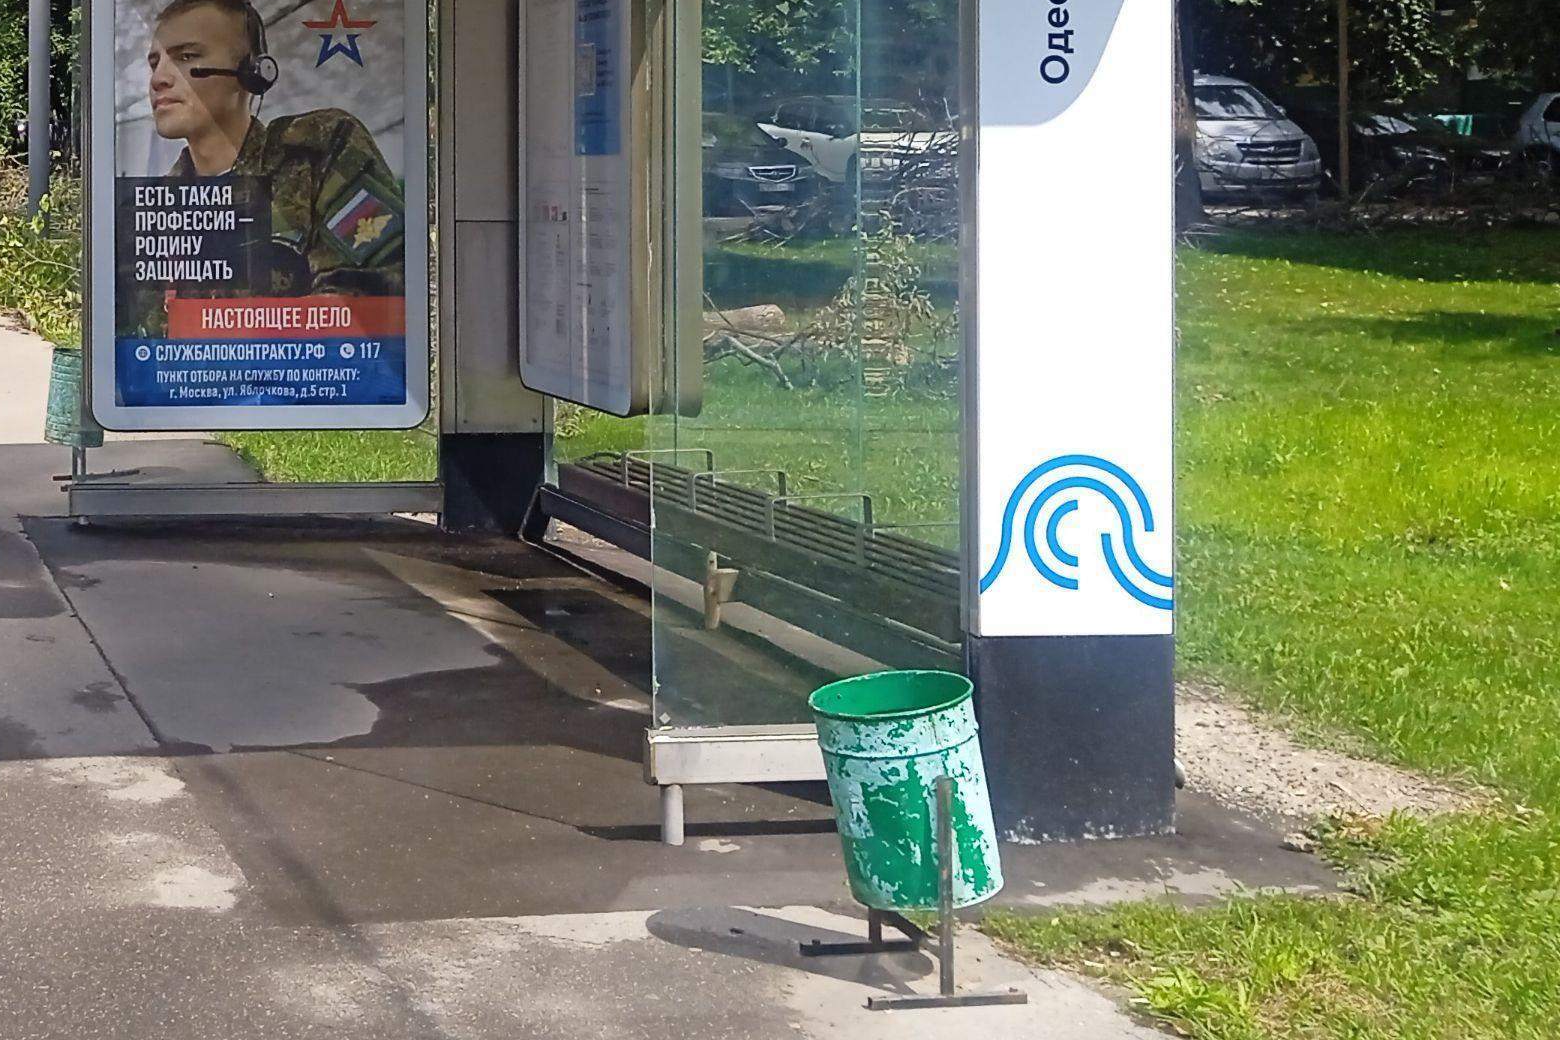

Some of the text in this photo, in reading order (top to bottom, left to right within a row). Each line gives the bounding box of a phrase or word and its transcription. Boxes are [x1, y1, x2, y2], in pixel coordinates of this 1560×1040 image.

[135, 185, 232, 207] ЕСТЬ ТАКАЯ
[135, 210, 236, 231] ПРОФЕССИЯ
[135, 235, 203, 258] РОДИНУ
[135, 260, 233, 283] ЗАЩИЩАТЬ
[201, 307, 352, 330] НАСТОЯЩЕЕ ДЕЛО
[155, 342, 381, 362] СЛУЖБАПОКОНТРАКТУ.РФ 117
[156, 369, 360, 383] ПУНКТ ОТБОРА НА СЛУЖБУ ПО КОНТРАКТУ:
[169, 389, 178, 399] г.
[179, 385, 222, 399] Москва,
[223, 386, 238, 399] ул.
[239, 385, 299, 398] Яблочкова,
[318, 386, 339, 399] стр.
